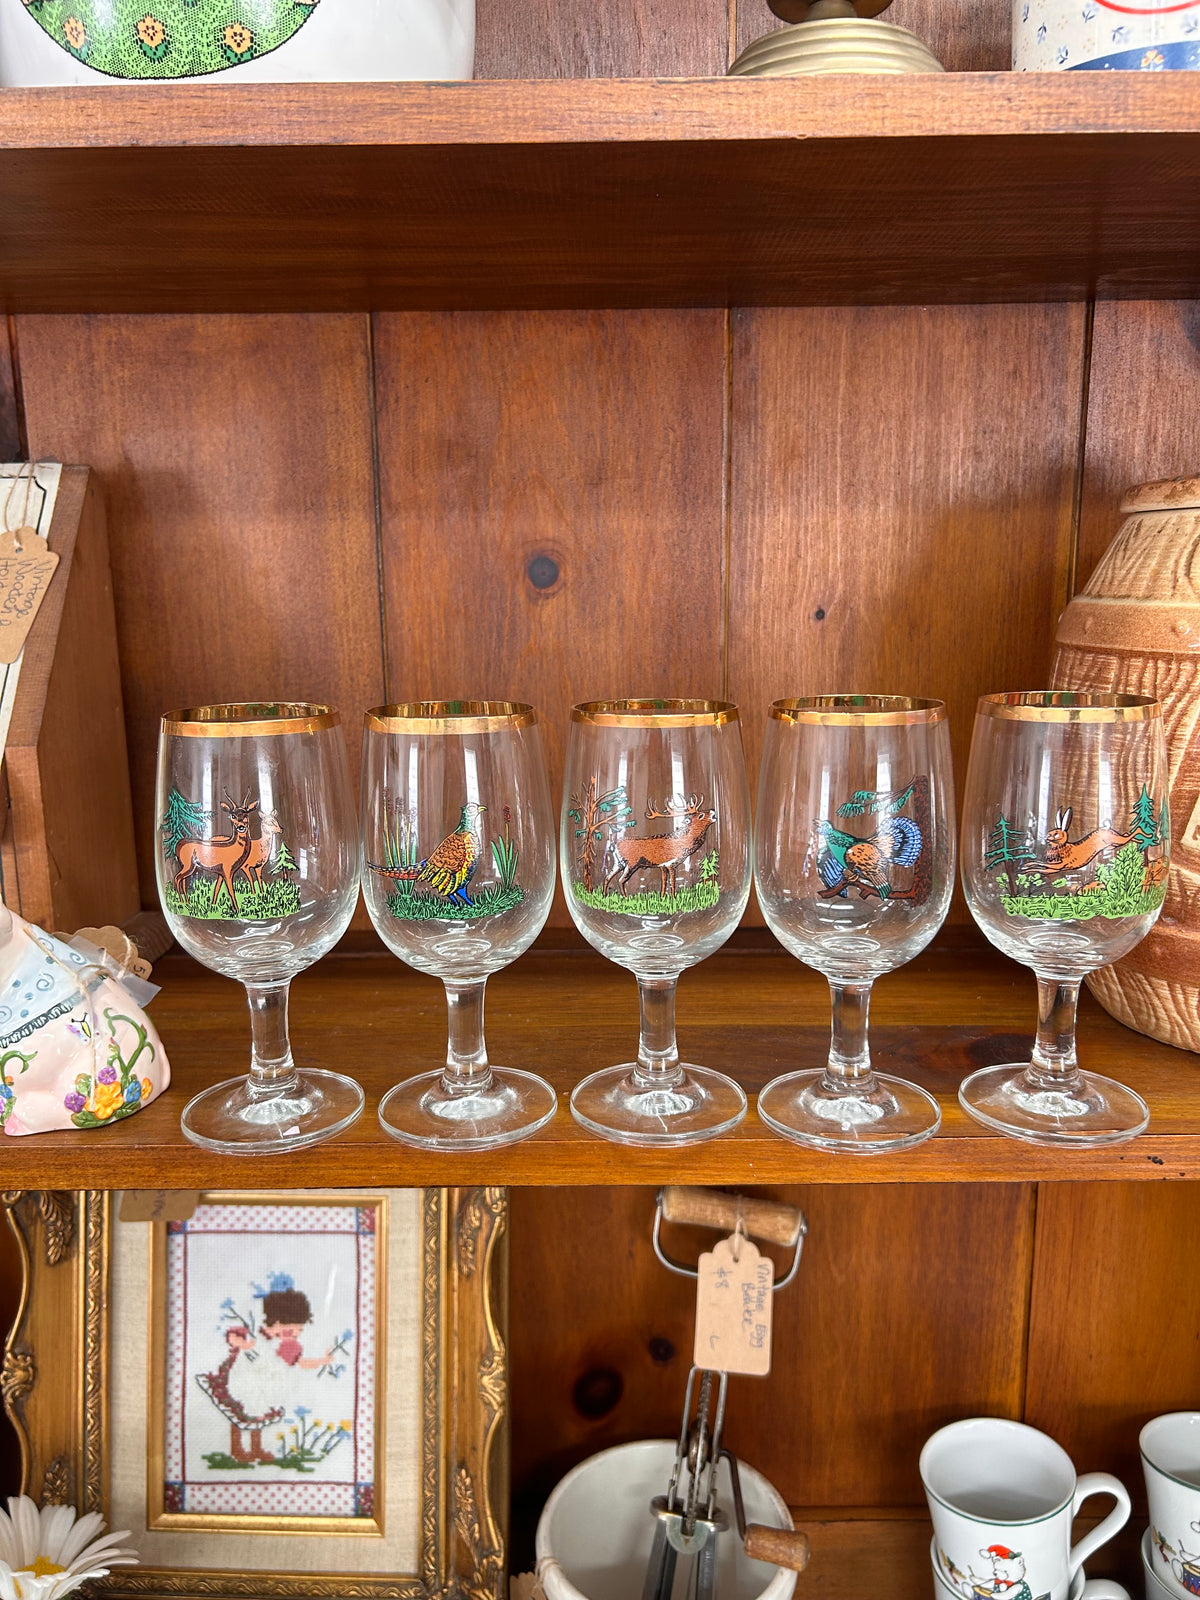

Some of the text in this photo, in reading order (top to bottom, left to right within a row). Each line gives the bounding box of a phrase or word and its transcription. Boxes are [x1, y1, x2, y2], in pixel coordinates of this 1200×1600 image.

[1, 558, 37, 613] Wooden
[16, 560, 52, 618] Vintage
[753, 1263, 770, 1312] Vintage
